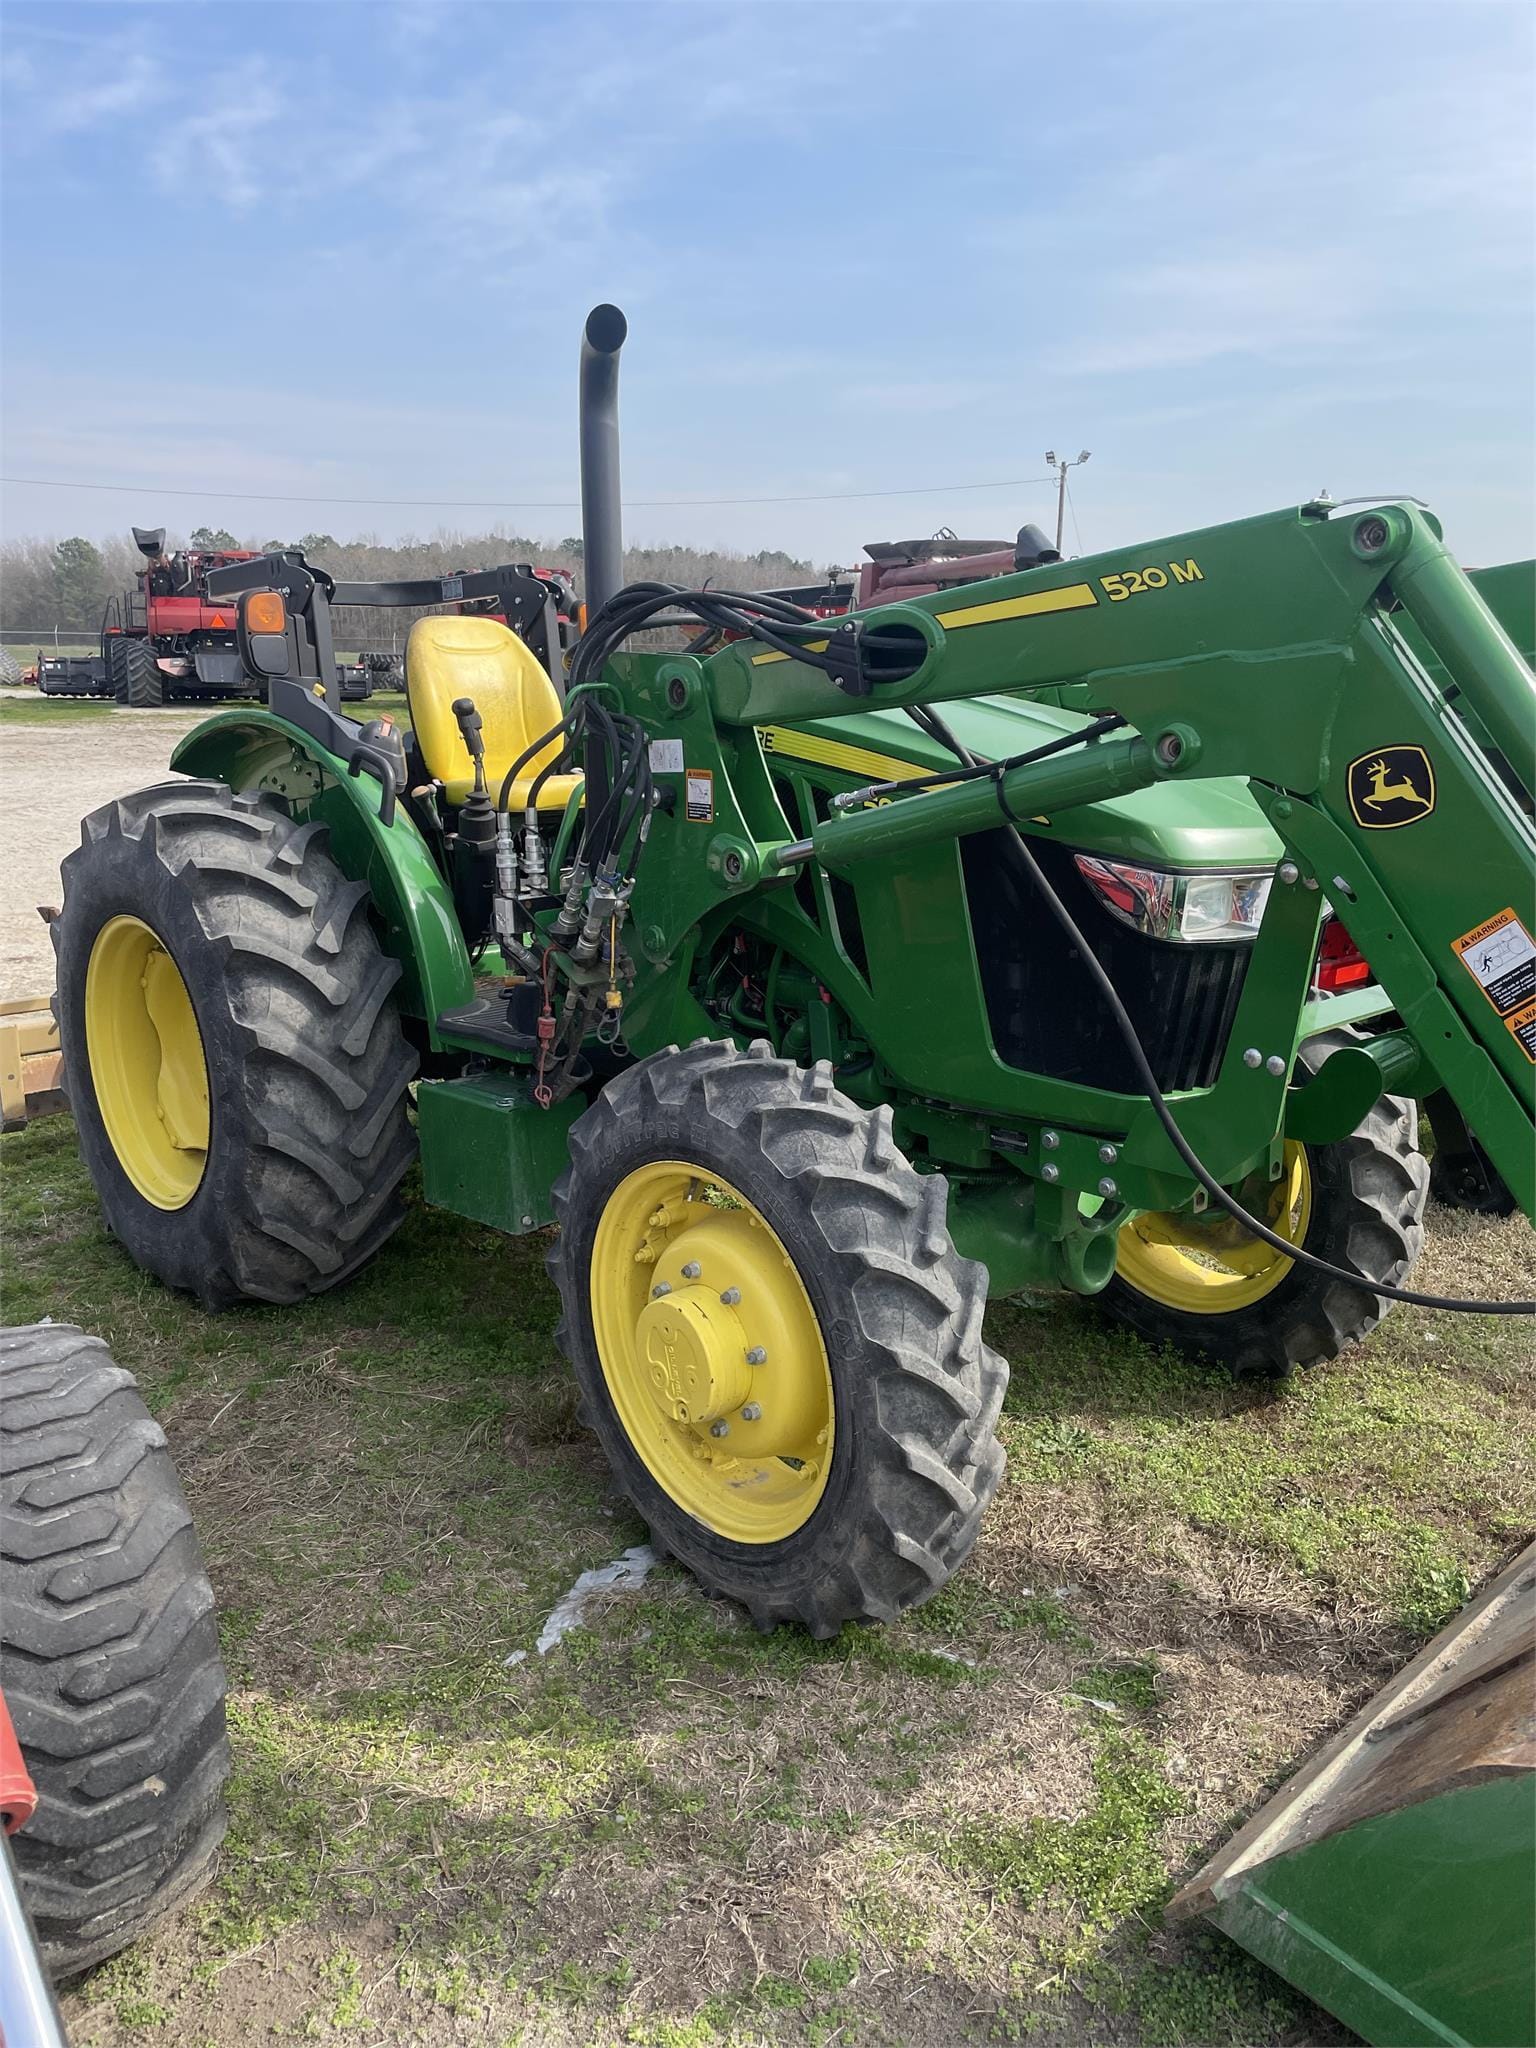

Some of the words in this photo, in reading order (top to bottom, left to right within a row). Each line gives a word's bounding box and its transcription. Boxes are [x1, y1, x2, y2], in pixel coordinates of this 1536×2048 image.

[1100, 566, 1168, 601] 520
[1168, 558, 1204, 584] M
[1468, 915, 1509, 942] WARNING
